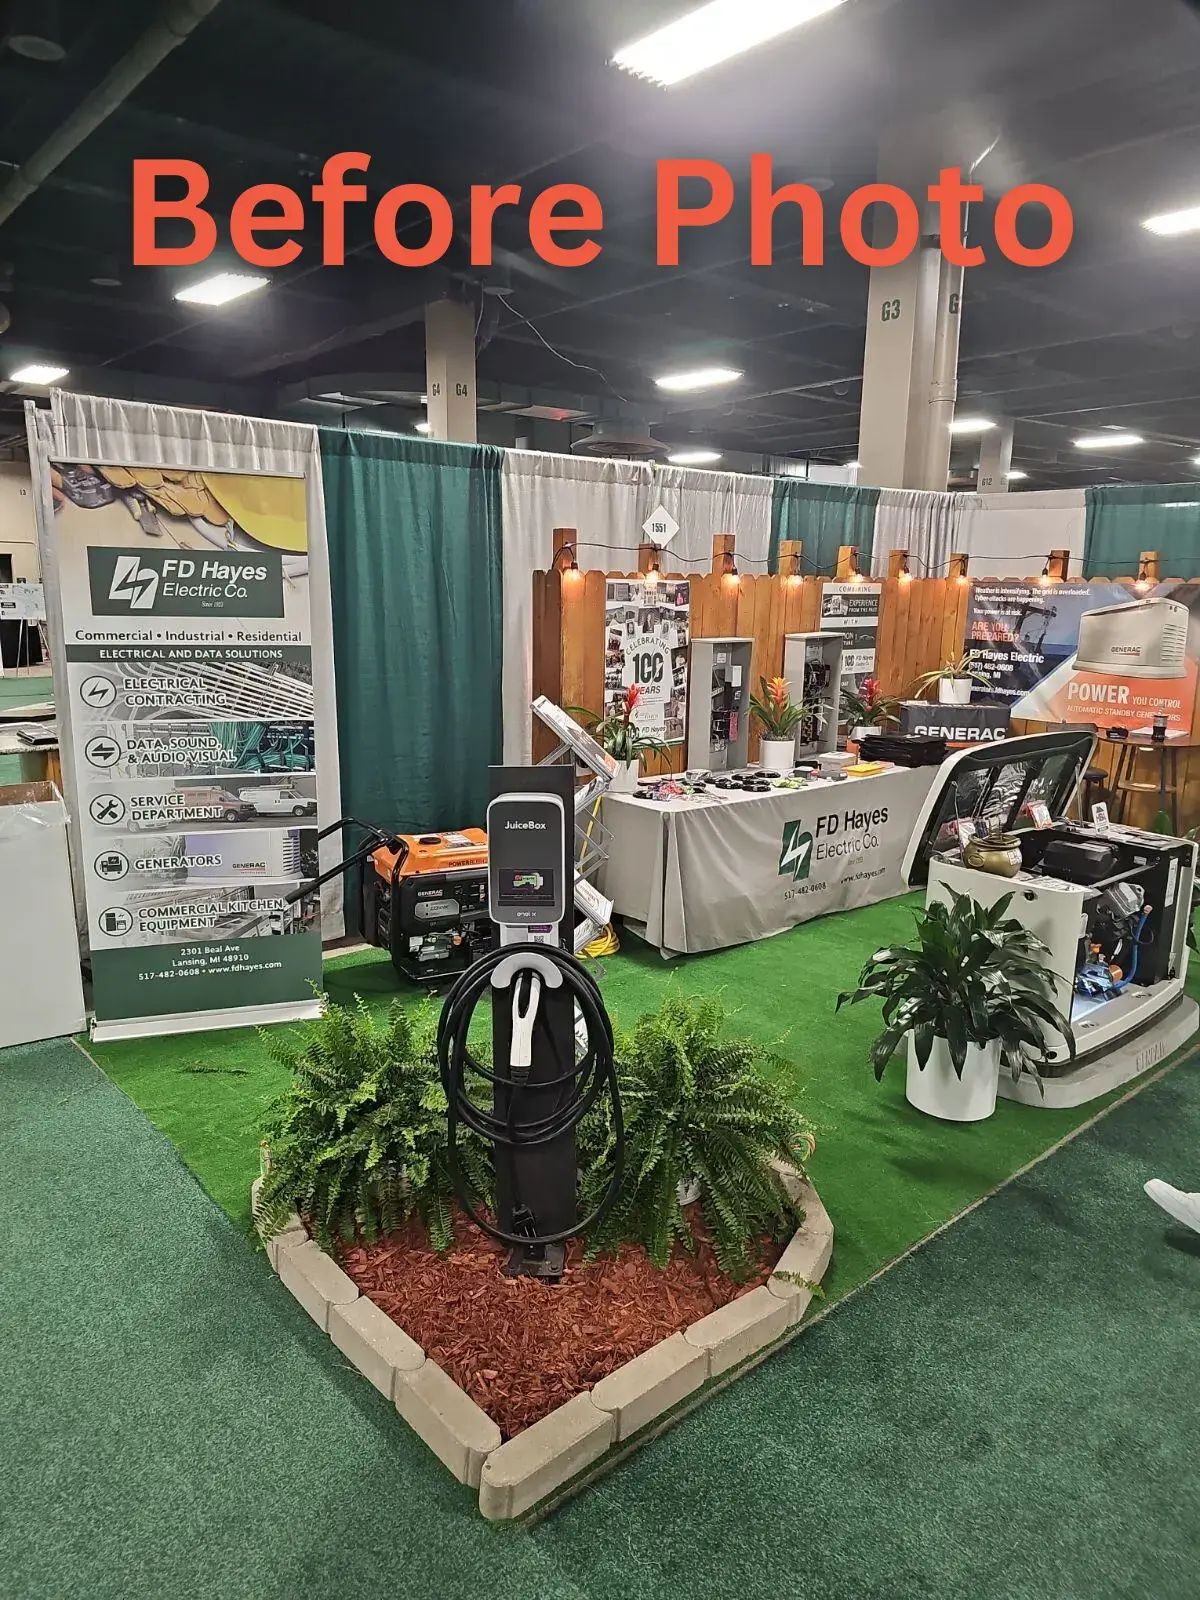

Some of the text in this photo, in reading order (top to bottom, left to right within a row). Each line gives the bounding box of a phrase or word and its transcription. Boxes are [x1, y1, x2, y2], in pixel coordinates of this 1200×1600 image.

[881, 299, 900, 321] G3
[949, 293, 959, 314] G
[455, 383, 467, 397] G4
[651, 522, 667, 533] 1551
[162, 559, 267, 583] FD Hayes
[162, 583, 248, 598] Electric Co.
[1042, 588, 1053, 597] grid
[849, 599, 878, 607] EXPERIENCE
[972, 621, 1008, 632] ARE YOU
[75, 629, 302, 642] Commercial Industrial Residential
[971, 631, 1020, 641] PREPARED?
[626, 636, 671, 656] CELEBRATING
[100, 649, 283, 659] ELECTRICAL AND DATA SOLUTIONS
[982, 650, 1009, 662] Hayes
[1010, 651, 1045, 664] Electric
[633, 652, 664, 684] 100
[993, 671, 1001, 679] MI
[124, 678, 206, 690] ELECTRICAL
[125, 694, 227, 706] CONTRACTING
[1067, 682, 1181, 709] POWER YOU CONTROL
[1067, 705, 1181, 721] AUTOMATIC STANDBY GENEORS
[914, 725, 1005, 741] GENERAC
[127, 737, 222, 750] DATA, SOUND,
[127, 751, 235, 763] & AUDIO VISUAL
[130, 795, 184, 807] SERVICE
[132, 807, 222, 820] DEPARTMENT
[504, 820, 546, 830] JuiceBox
[816, 807, 888, 838] FD Hayes
[816, 833, 879, 860] Electric Co.
[135, 855, 222, 869] GENERATORS
[784, 881, 827, 900] 517-482-0608
[138, 899, 283, 918] COMMERCIAL KITCHEN
[139, 918, 216, 932] EQUIPMENT
[180, 944, 240, 956] 2301 Beal Ave
[172, 957, 208, 967] Lansing,
[223, 954, 249, 962] 48910
[138, 962, 282, 980] 517-482-0608 www.fdhayes.com
